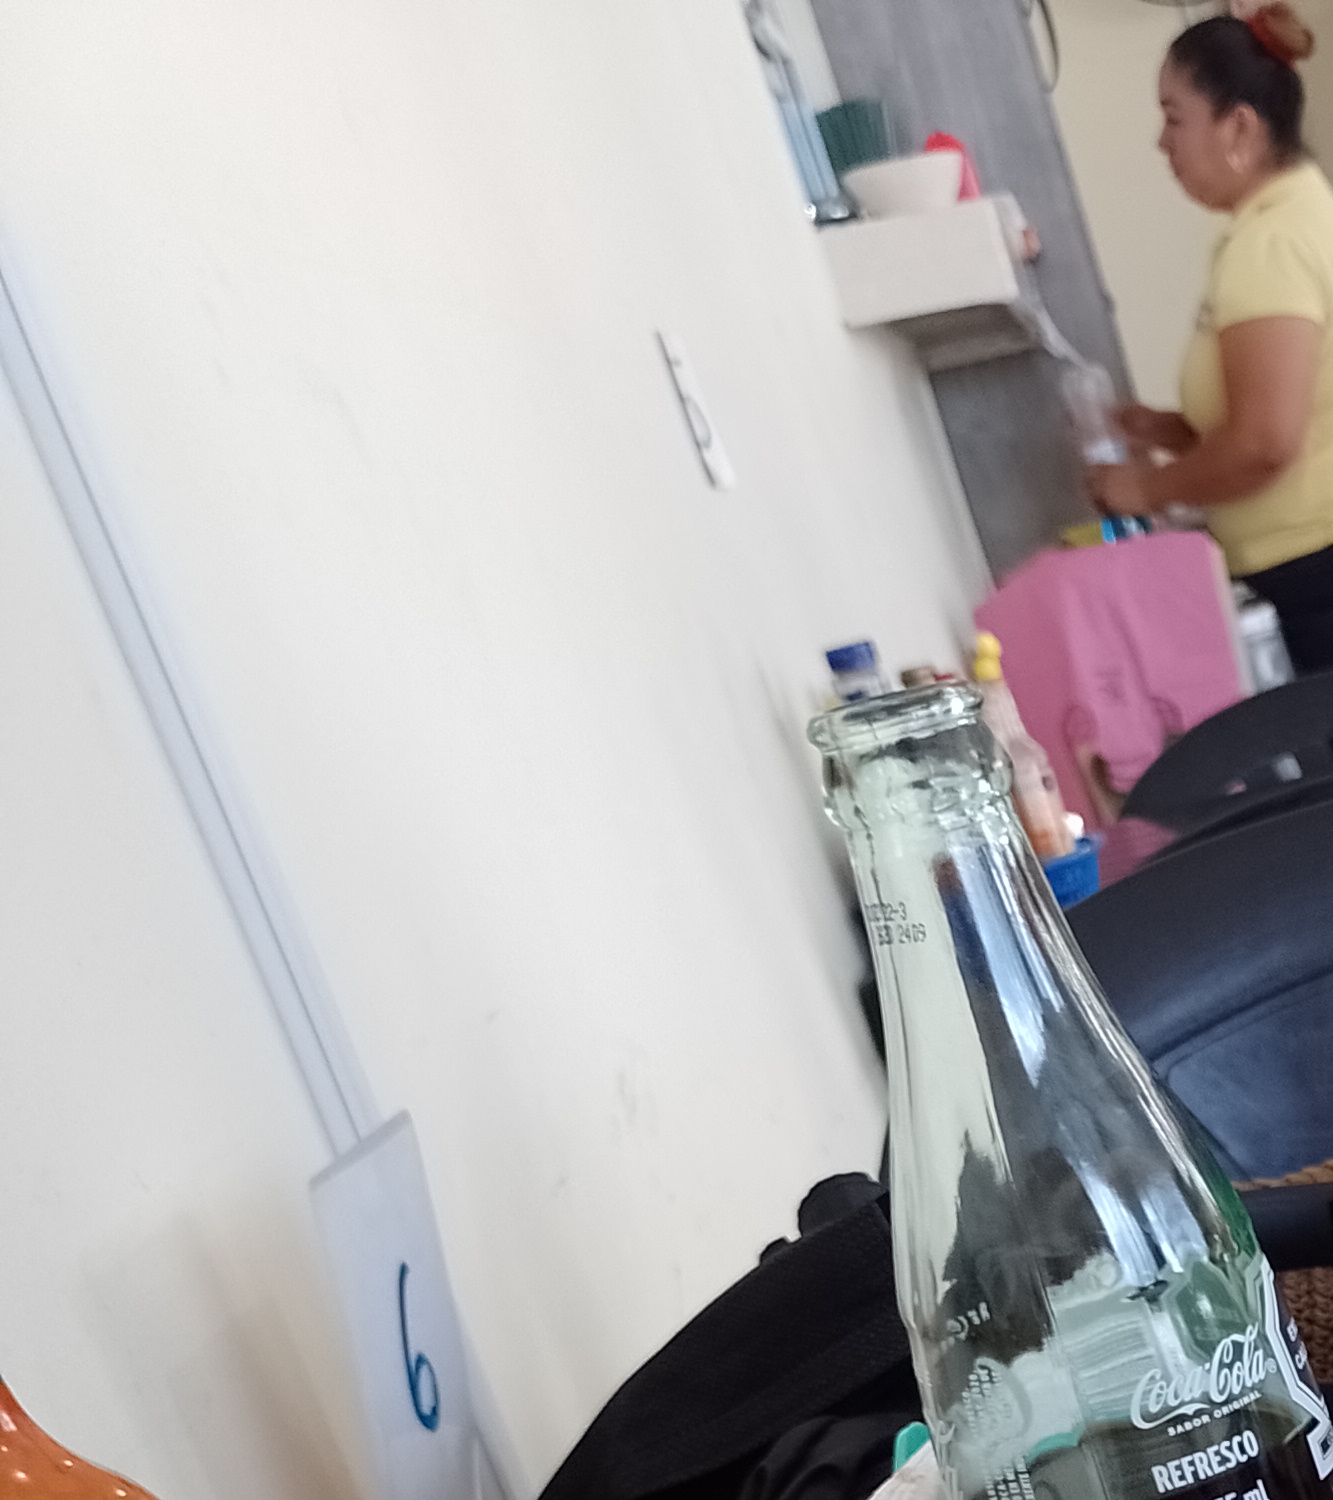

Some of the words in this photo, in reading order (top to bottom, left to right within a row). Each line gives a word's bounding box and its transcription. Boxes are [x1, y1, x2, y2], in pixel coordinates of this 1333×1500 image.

[399, 1262, 441, 1431] 6
[1130, 1322, 1266, 1430] Coca-Cola
[1167, 1414, 1211, 1436] SABOR
[1213, 1390, 1262, 1419] ORIGINAL
[1150, 1430, 1259, 1494] REFRESCO
